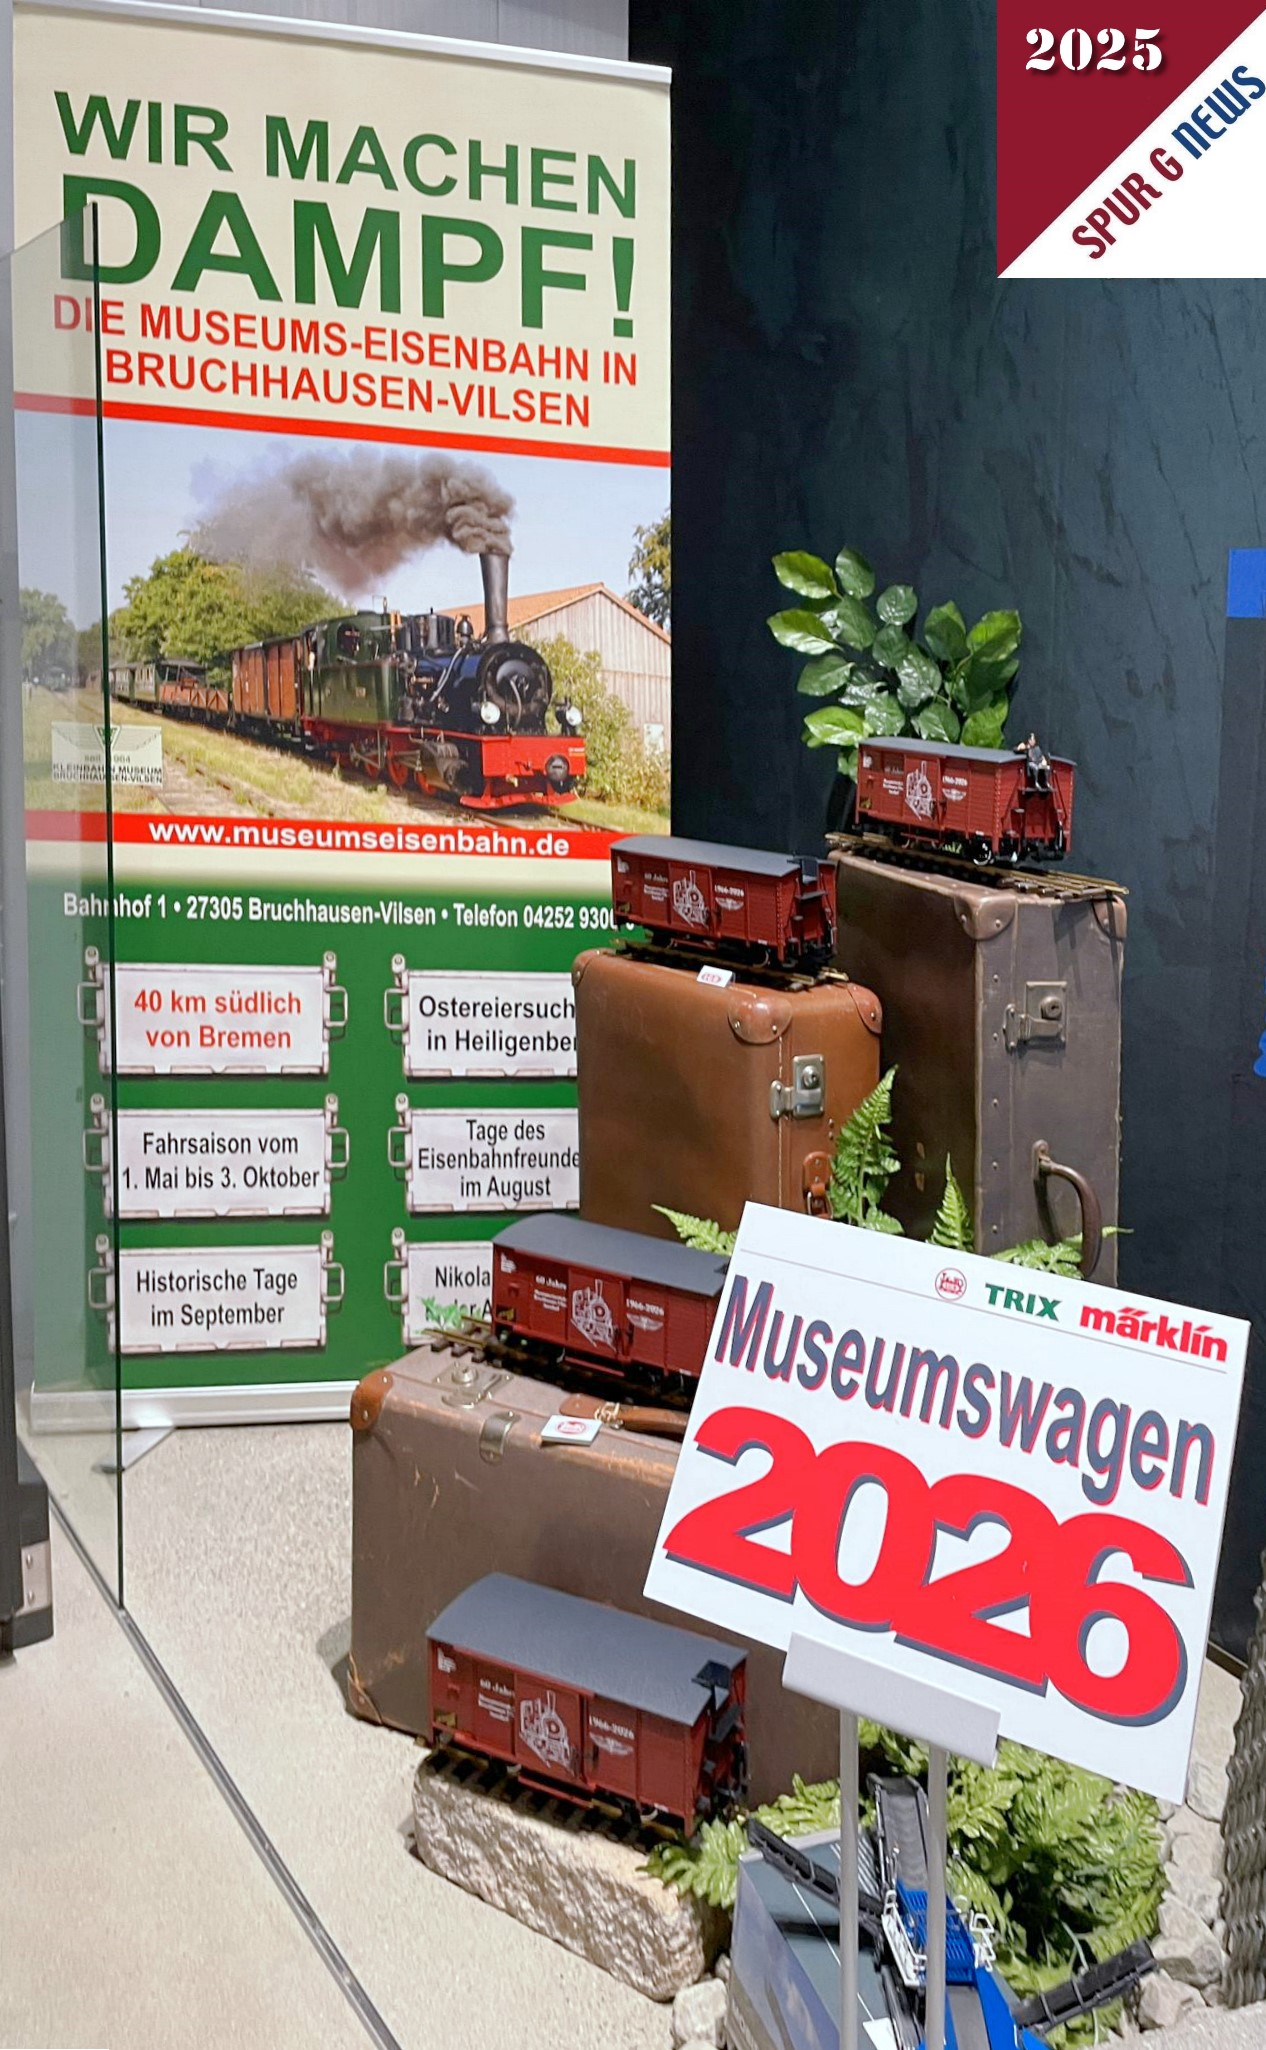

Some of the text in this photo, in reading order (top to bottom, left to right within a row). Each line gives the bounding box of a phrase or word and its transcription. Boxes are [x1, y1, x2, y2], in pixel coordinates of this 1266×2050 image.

[53, 91, 637, 219] WIR MACHEN
[60, 173, 635, 339] DAMPF!
[54, 294, 638, 386] DIE MUSEUMS-EISENBAHN IN
[106, 348, 590, 428] BRUCHHAUSEN-VILSEN
[149, 822, 570, 855] www.museumseisenbahn.de
[64, 892, 152, 918] Bahnhof
[158, 895, 167, 918] 1
[187, 896, 242, 920] 27305
[248, 897, 436, 925] Bruchhausen-Vilsen
[453, 902, 518, 928] Telefon
[523, 905, 575, 929] 04252
[134, 989, 301, 1015] 40 km südlich
[418, 996, 576, 1019] Ostereiersuch
[146, 1025, 291, 1049] von Bremen
[426, 1029, 447, 1051] in
[143, 1131, 299, 1155] Fahrsaison vom
[465, 1118, 545, 1146] Tage des
[418, 1146, 580, 1170] Eisenbahnfreunde
[122, 1165, 320, 1190] 1. Mai bis 3. Oktober
[460, 1175, 551, 1201] im August
[137, 1268, 298, 1295] Historische Tage
[435, 1265, 491, 1289] Nikola
[151, 1303, 285, 1332] im September
[985, 1282, 1063, 1322] TRIX
[1079, 1305, 1228, 1363] märklin
[714, 1273, 1216, 1507] Museumswagen
[662, 1406, 1196, 1728] 2026
